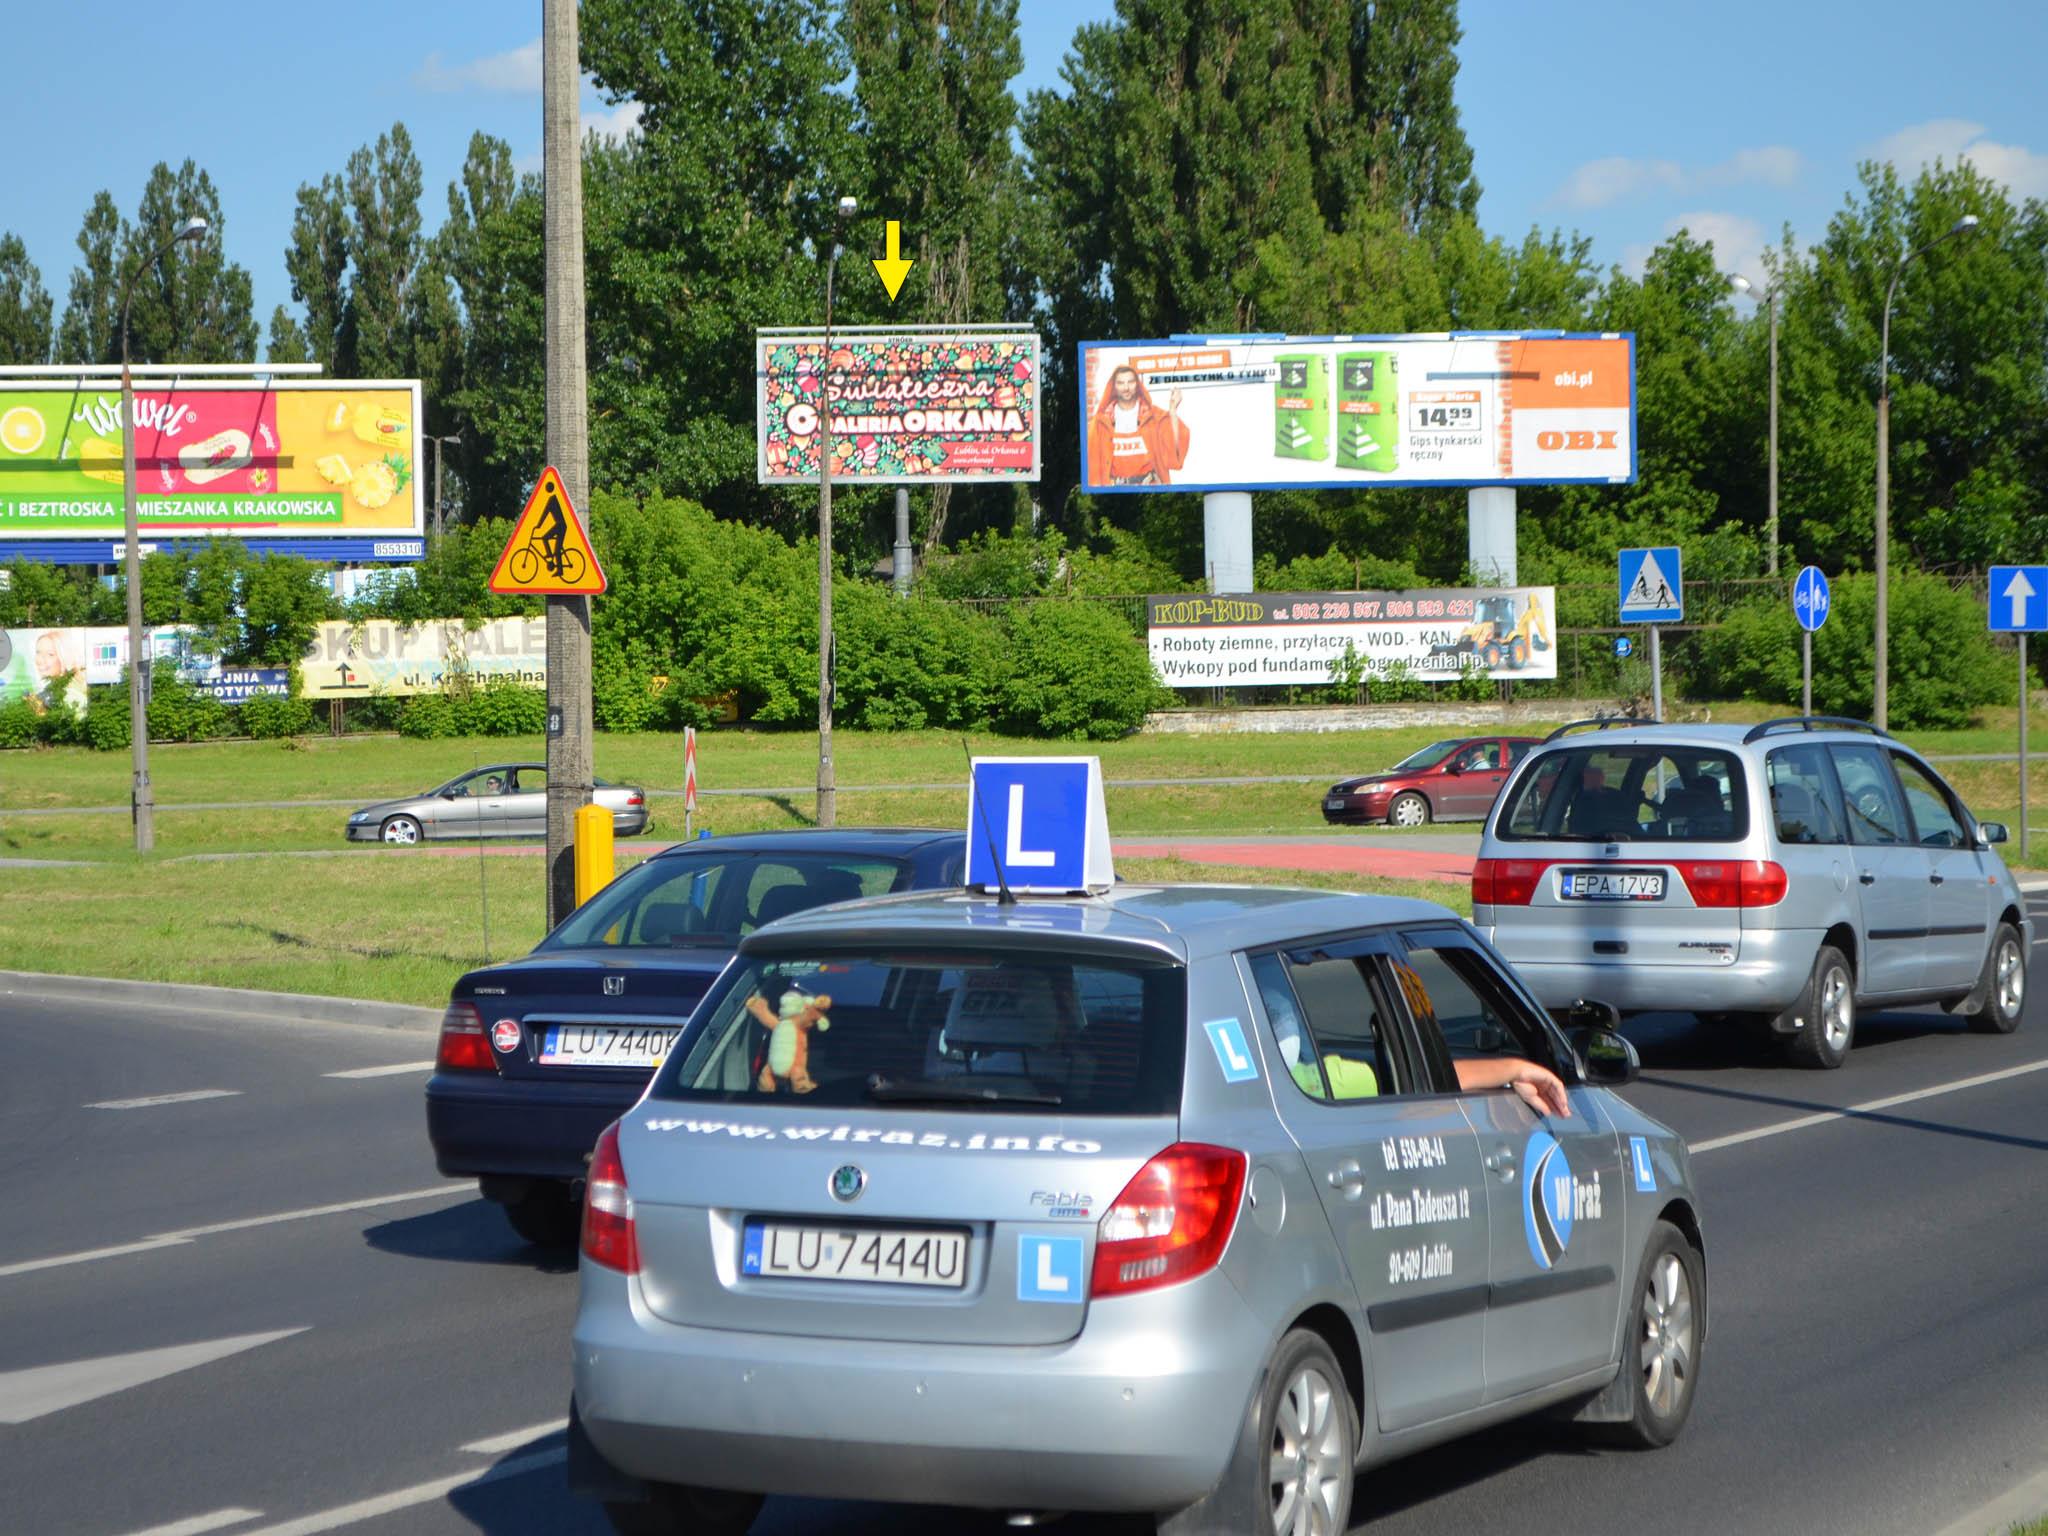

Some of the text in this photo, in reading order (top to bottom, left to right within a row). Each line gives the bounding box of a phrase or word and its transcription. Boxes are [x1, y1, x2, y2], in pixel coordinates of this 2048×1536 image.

[1554, 369, 1593, 388] obi.pl
[903, 408, 1025, 434] ORKANA
[1409, 436, 1483, 448] Gips tynkarski
[1537, 431, 1618, 451] OBI
[1409, 450, 1444, 462] ręczny
[19, 501, 116, 518] BEZTROSKA
[136, 500, 229, 516] MIESZANKA
[233, 499, 336, 516] KRAKOWSKA
[375, 543, 421, 556] 8553310
[1154, 598, 1264, 623] KOP-BUD
[304, 621, 547, 663] SKUP PALE
[1163, 636, 1216, 654] Roboty
[1219, 635, 1279, 651] ziemne,
[1283, 633, 1354, 654] przyłącza
[403, 668, 546, 687] ul. Krchmalna
[1163, 660, 1224, 678] Wykopy
[1228, 657, 1257, 676] pod
[1005, 784, 1056, 867] L
[1574, 876, 1660, 895] EPA 17V3
[561, 1028, 599, 1055] LU
[1217, 1027, 1249, 1072] L
[645, 1118, 1102, 1154] www.wiraz.info
[1636, 1144, 1651, 1183] L
[1030, 1191, 1094, 1207] Fabia
[1370, 1194, 1386, 1230] ul.
[1386, 1192, 1413, 1228] Pana
[1412, 1187, 1458, 1225] Tadeusza
[745, 1254, 760, 1267] PL
[770, 1229, 959, 1280] LU 7444U
[1389, 1242, 1453, 1285] 20-609 Lublin
[1037, 1243, 1069, 1293] L
